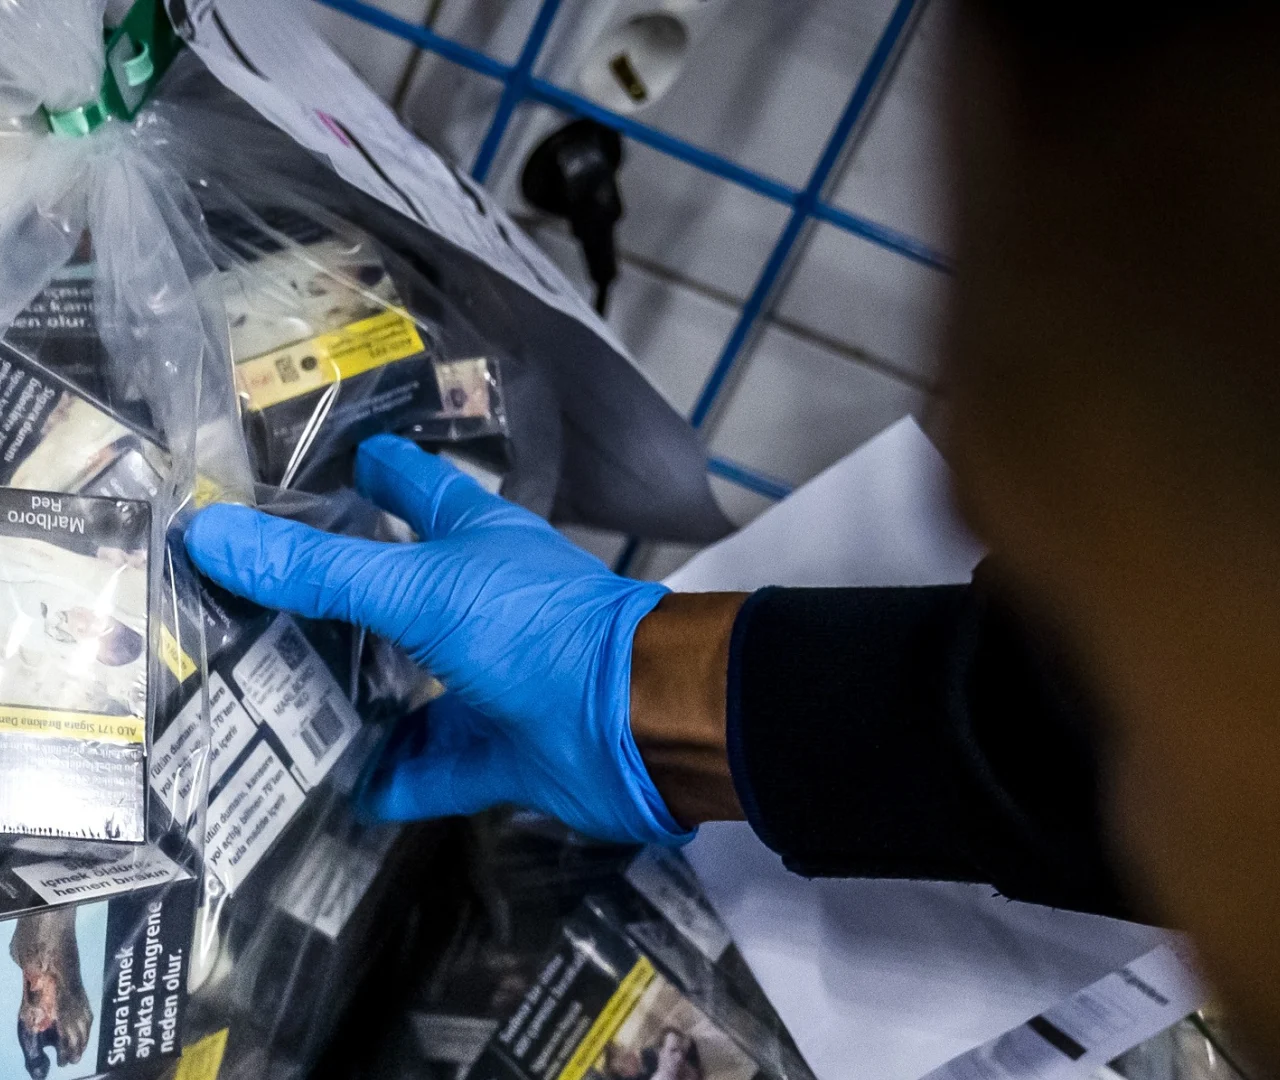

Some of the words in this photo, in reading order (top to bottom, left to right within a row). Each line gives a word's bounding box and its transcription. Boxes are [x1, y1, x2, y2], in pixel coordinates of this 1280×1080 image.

[29, 495, 62, 511] Red
[6, 510, 86, 533] Marlboro
[19, 717, 62, 730] Bırakma
[63, 718, 95, 732] Sigara
[97, 723, 114, 734] 171
[116, 724, 137, 736] ALO
[156, 778, 176, 798] yol
[200, 820, 224, 847] ütün
[207, 846, 225, 866] yol
[225, 842, 248, 868] fazla
[40, 869, 89, 892] içmek
[52, 876, 112, 901] hemen
[136, 897, 170, 995] kangrene
[110, 942, 141, 1006] içmek
[161, 946, 185, 992] olur.
[105, 1003, 133, 1067] Sigara
[130, 994, 159, 1060] ayakta
[158, 993, 180, 1054] neden
